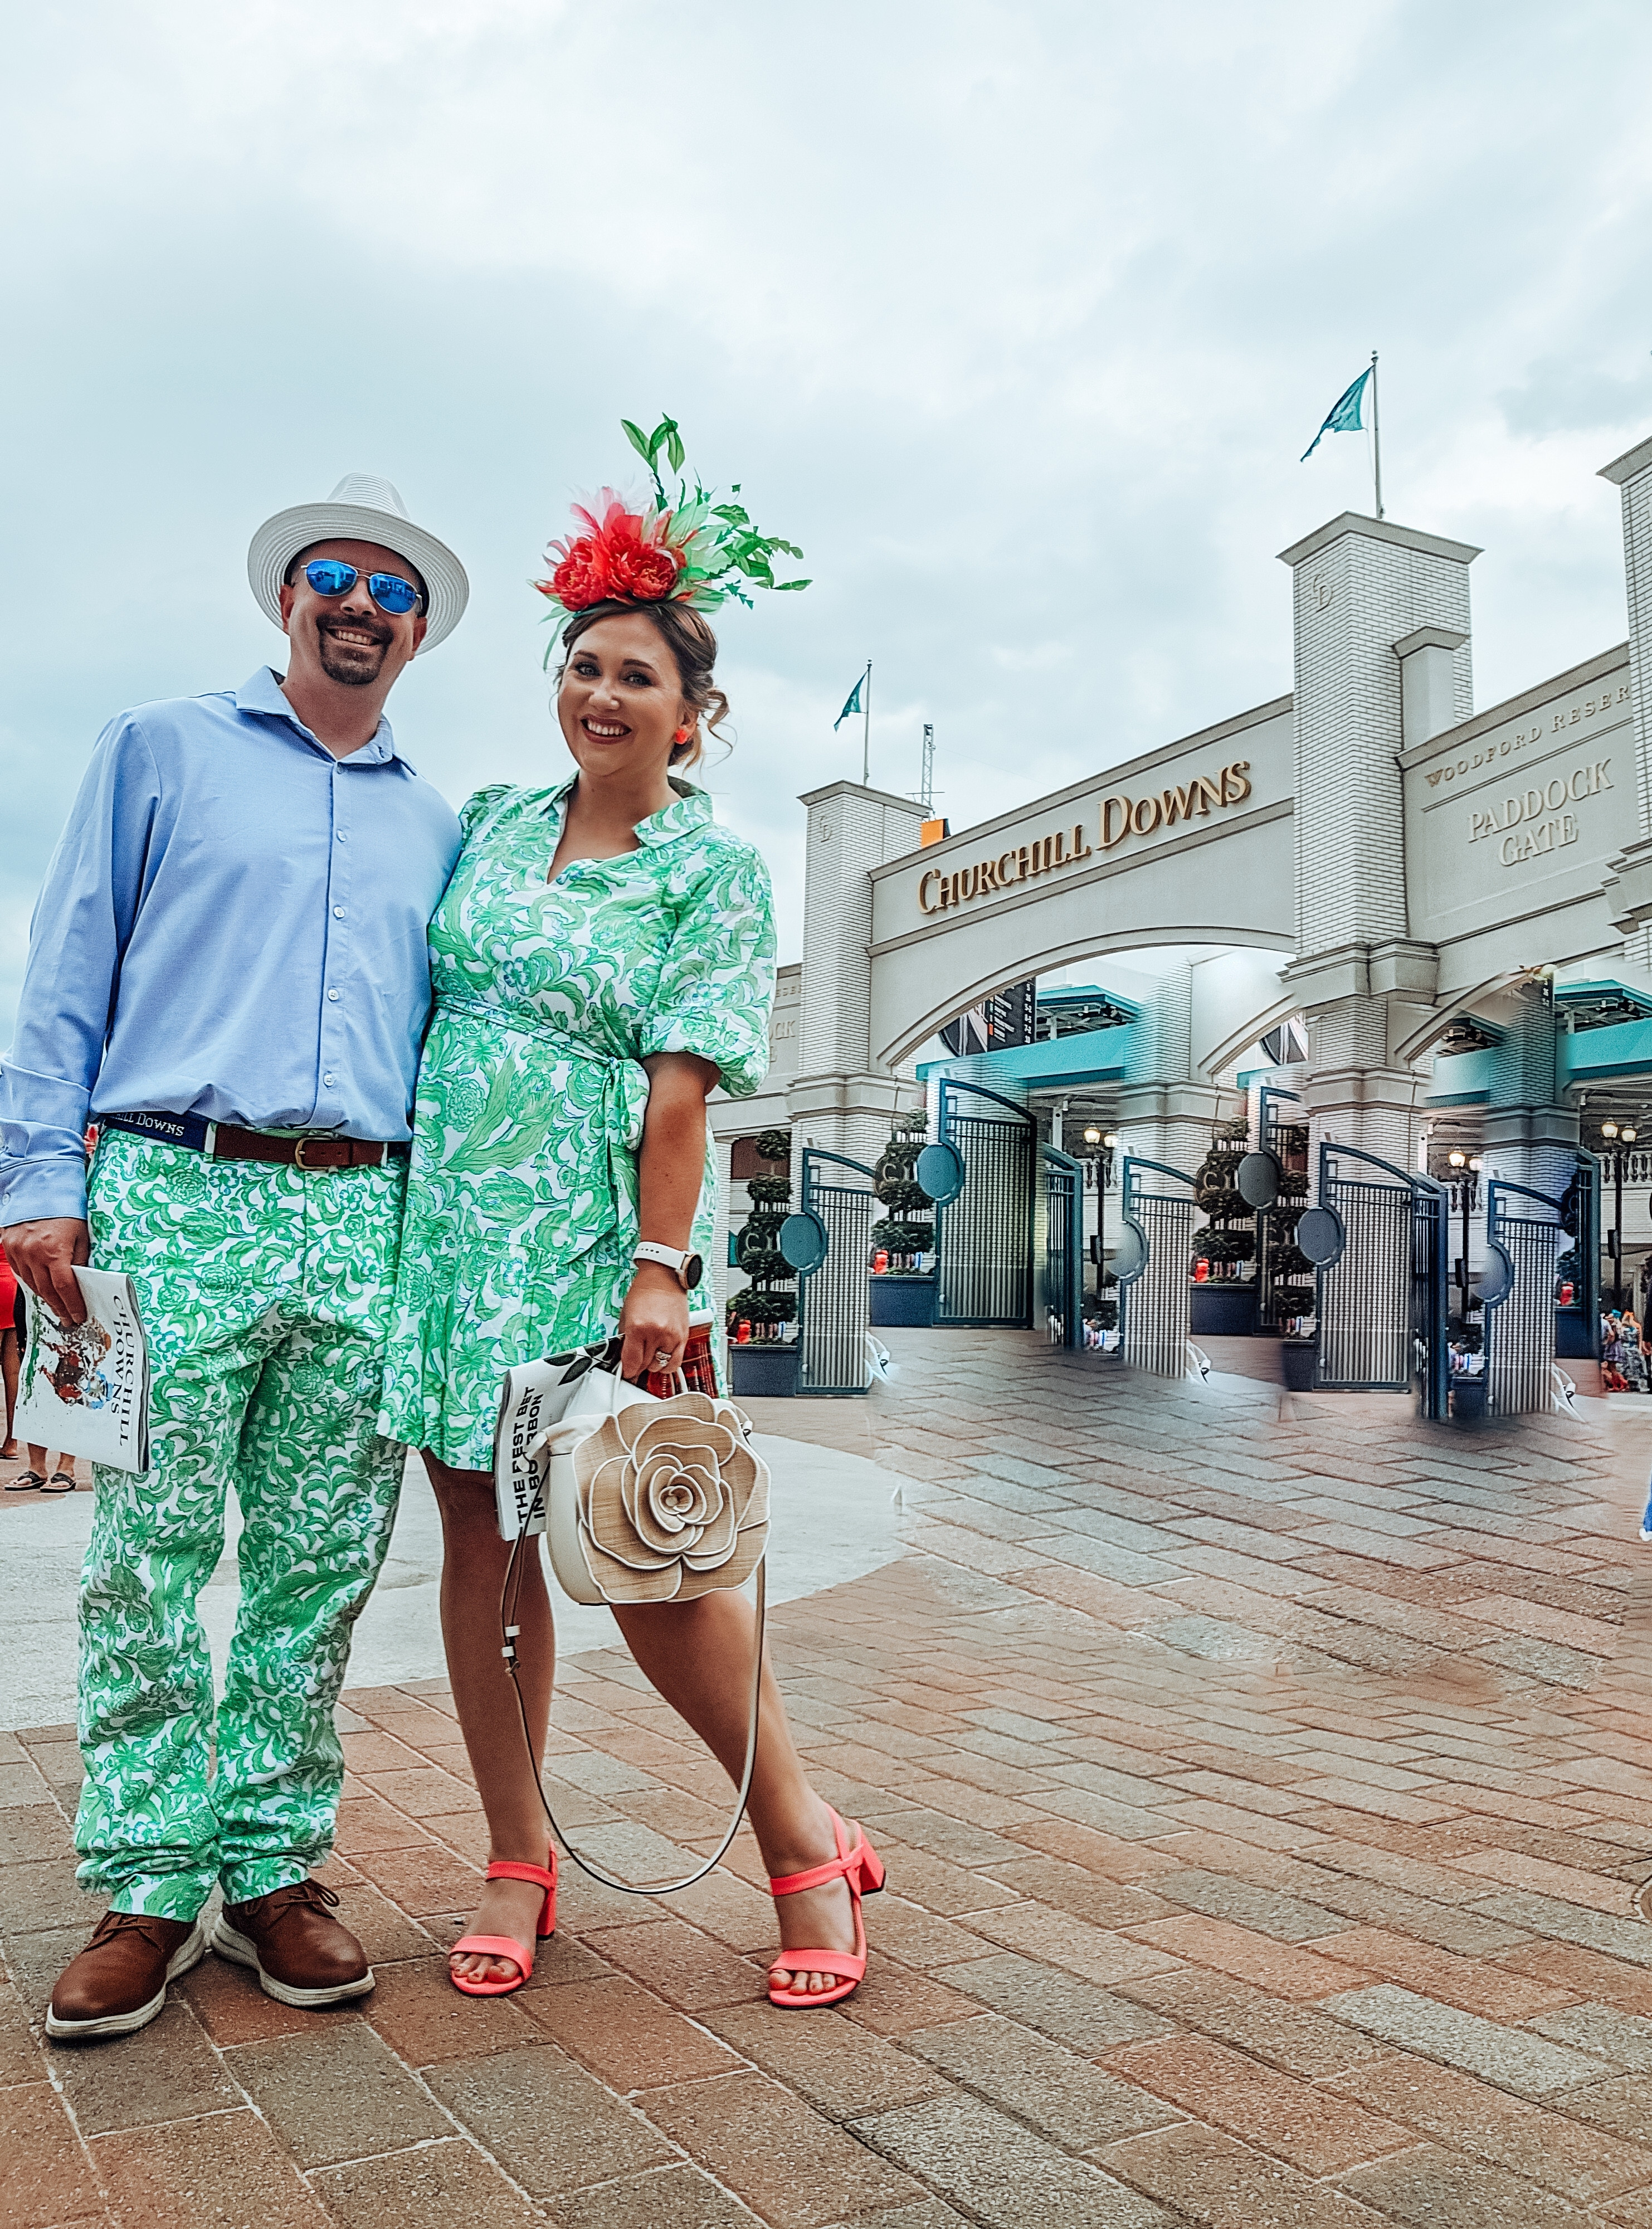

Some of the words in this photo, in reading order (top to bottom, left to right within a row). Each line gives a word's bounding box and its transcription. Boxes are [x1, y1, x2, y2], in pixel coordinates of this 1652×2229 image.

[1424, 726, 1542, 787] WOODFORD
[1468, 758, 1615, 843] PADDOCK
[917, 824, 1092, 914] CHURCHILL
[1095, 760, 1252, 851] DOWNS
[1498, 812, 1580, 867] GATE
[135, 1113, 185, 1136] DOWNS
[111, 1320, 124, 1414] DOWNS
[113, 1295, 134, 1446] CHURCHILL
[516, 1386, 535, 1417] BET
[527, 1394, 544, 1490] BORBON
[513, 1479, 528, 1524] THE
[533, 1497, 546, 1519] IN
